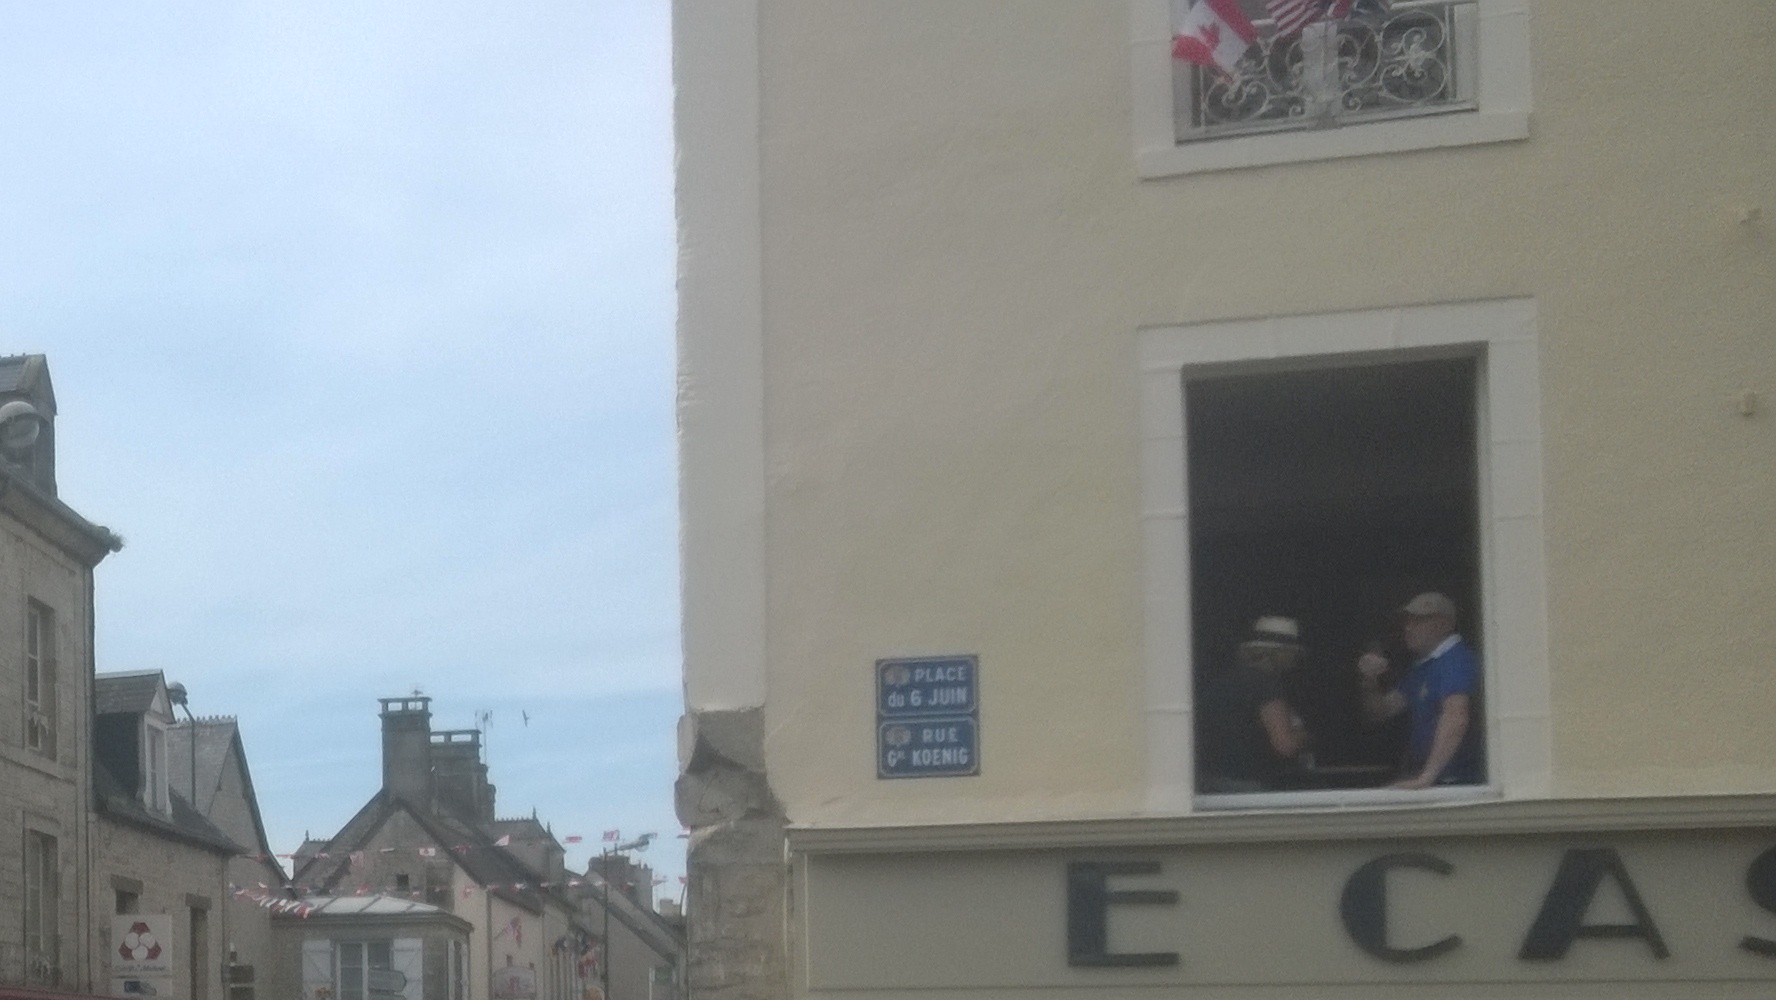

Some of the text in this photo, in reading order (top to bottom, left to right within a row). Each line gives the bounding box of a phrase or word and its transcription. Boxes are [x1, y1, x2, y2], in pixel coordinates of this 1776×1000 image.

[914, 666, 966, 682] PLACE
[887, 687, 968, 708] du 6 JUIN
[922, 726, 959, 743] RUE
[911, 747, 969, 767] KOENIG
[1067, 860, 1180, 967] E
